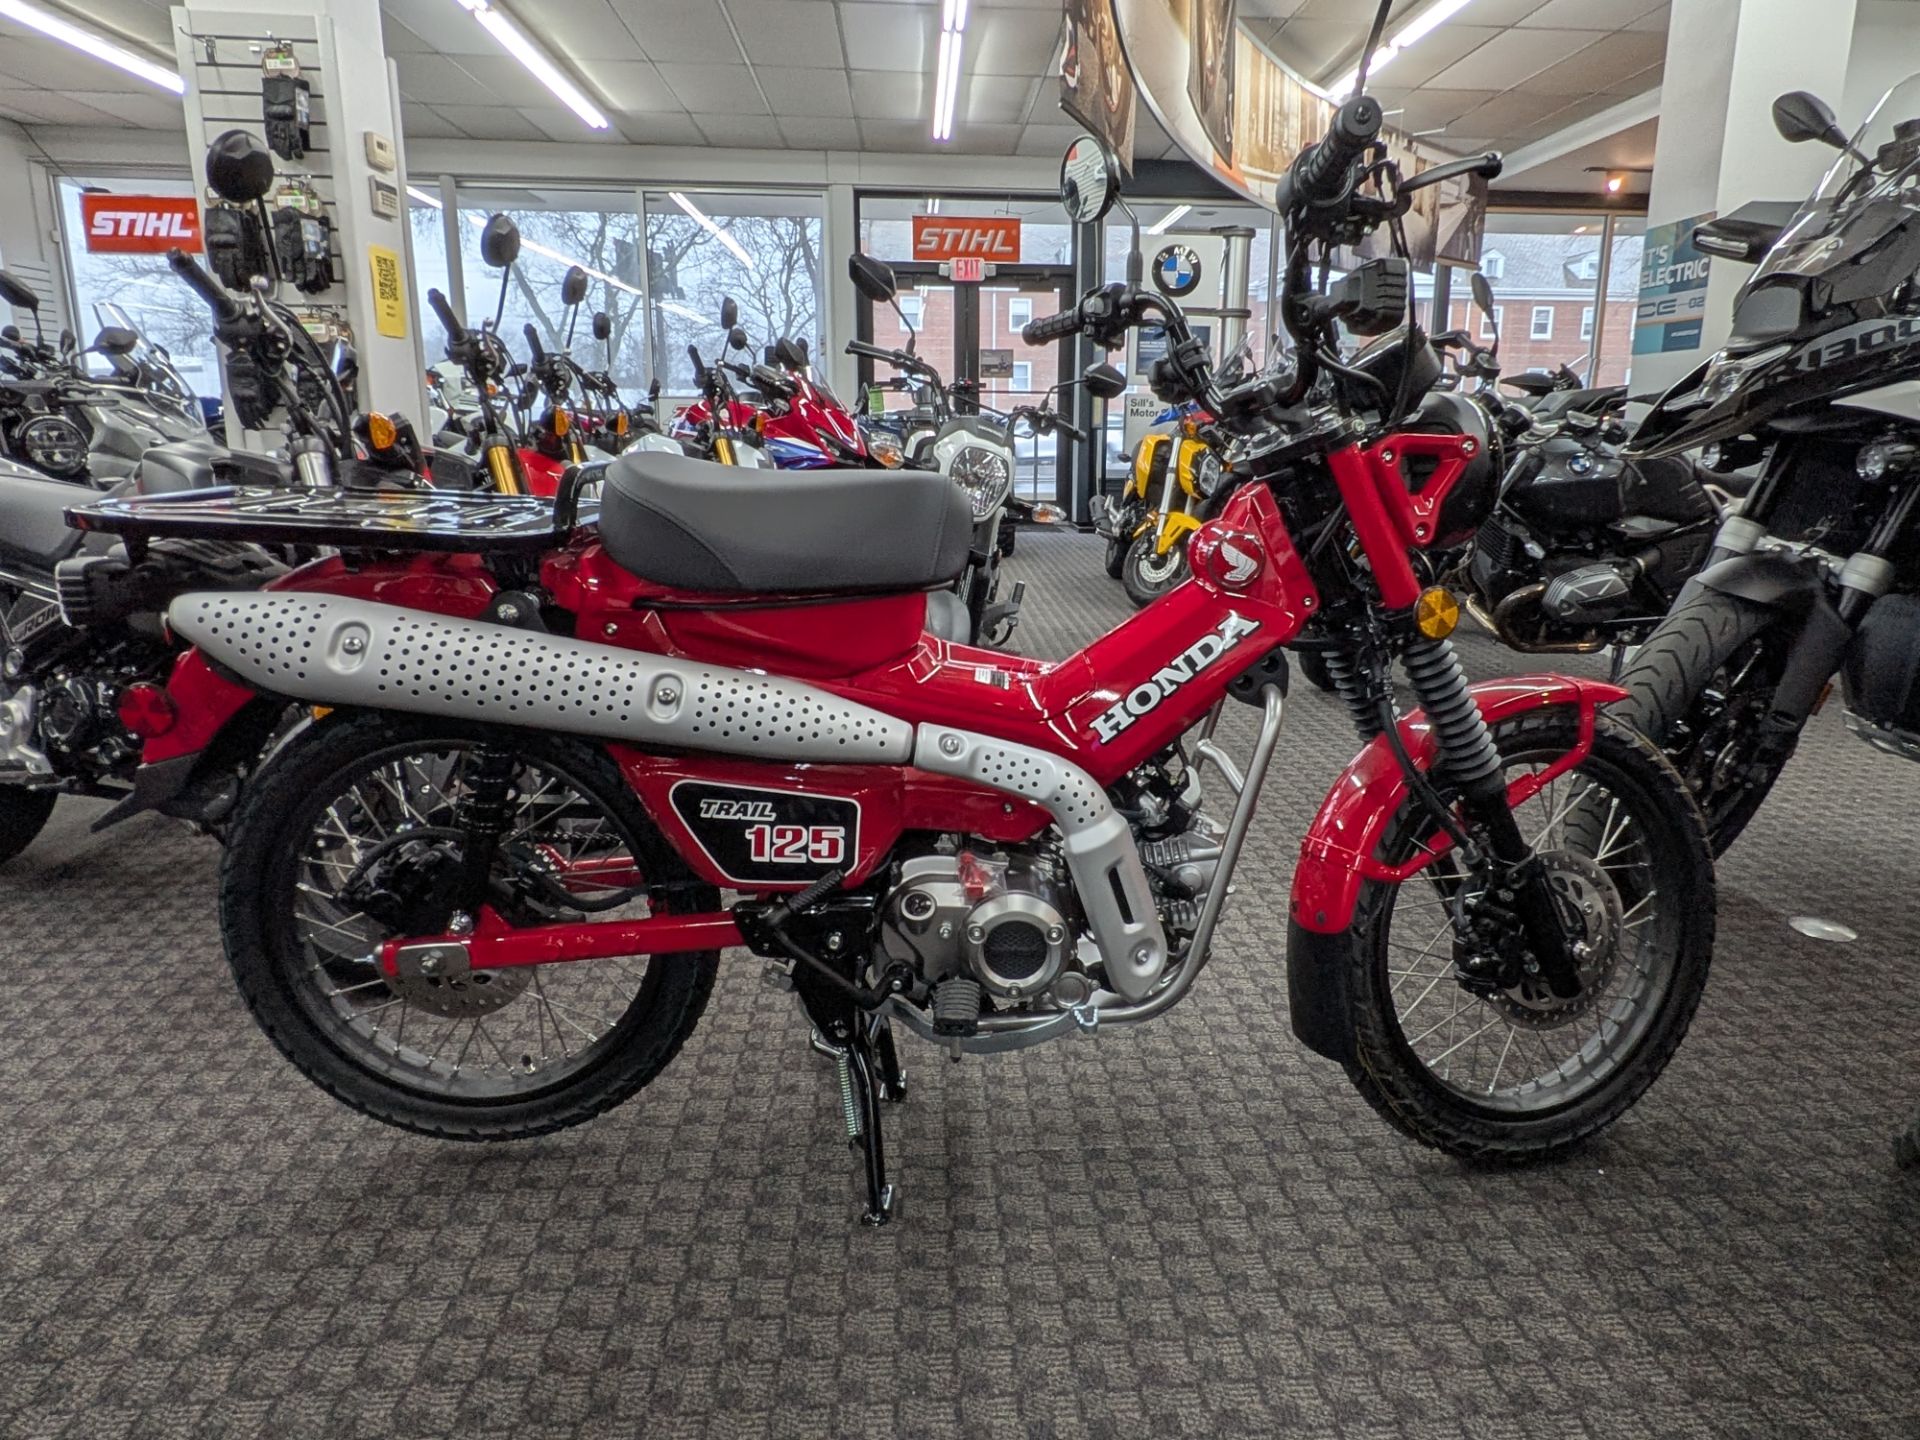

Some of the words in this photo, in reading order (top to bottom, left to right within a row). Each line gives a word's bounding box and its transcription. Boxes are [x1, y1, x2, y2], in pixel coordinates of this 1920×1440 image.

[91, 211, 193, 238] STIHL
[917, 227, 1014, 253] STIHL
[955, 259, 981, 279] EXIT
[1640, 257, 1709, 289] ELECTRIC
[1130, 398, 1154, 408] Sill's
[1130, 408, 1159, 418] Motor
[1089, 611, 1261, 744] HONDA
[700, 799, 776, 822] TRAIL
[745, 824, 846, 864] 125
